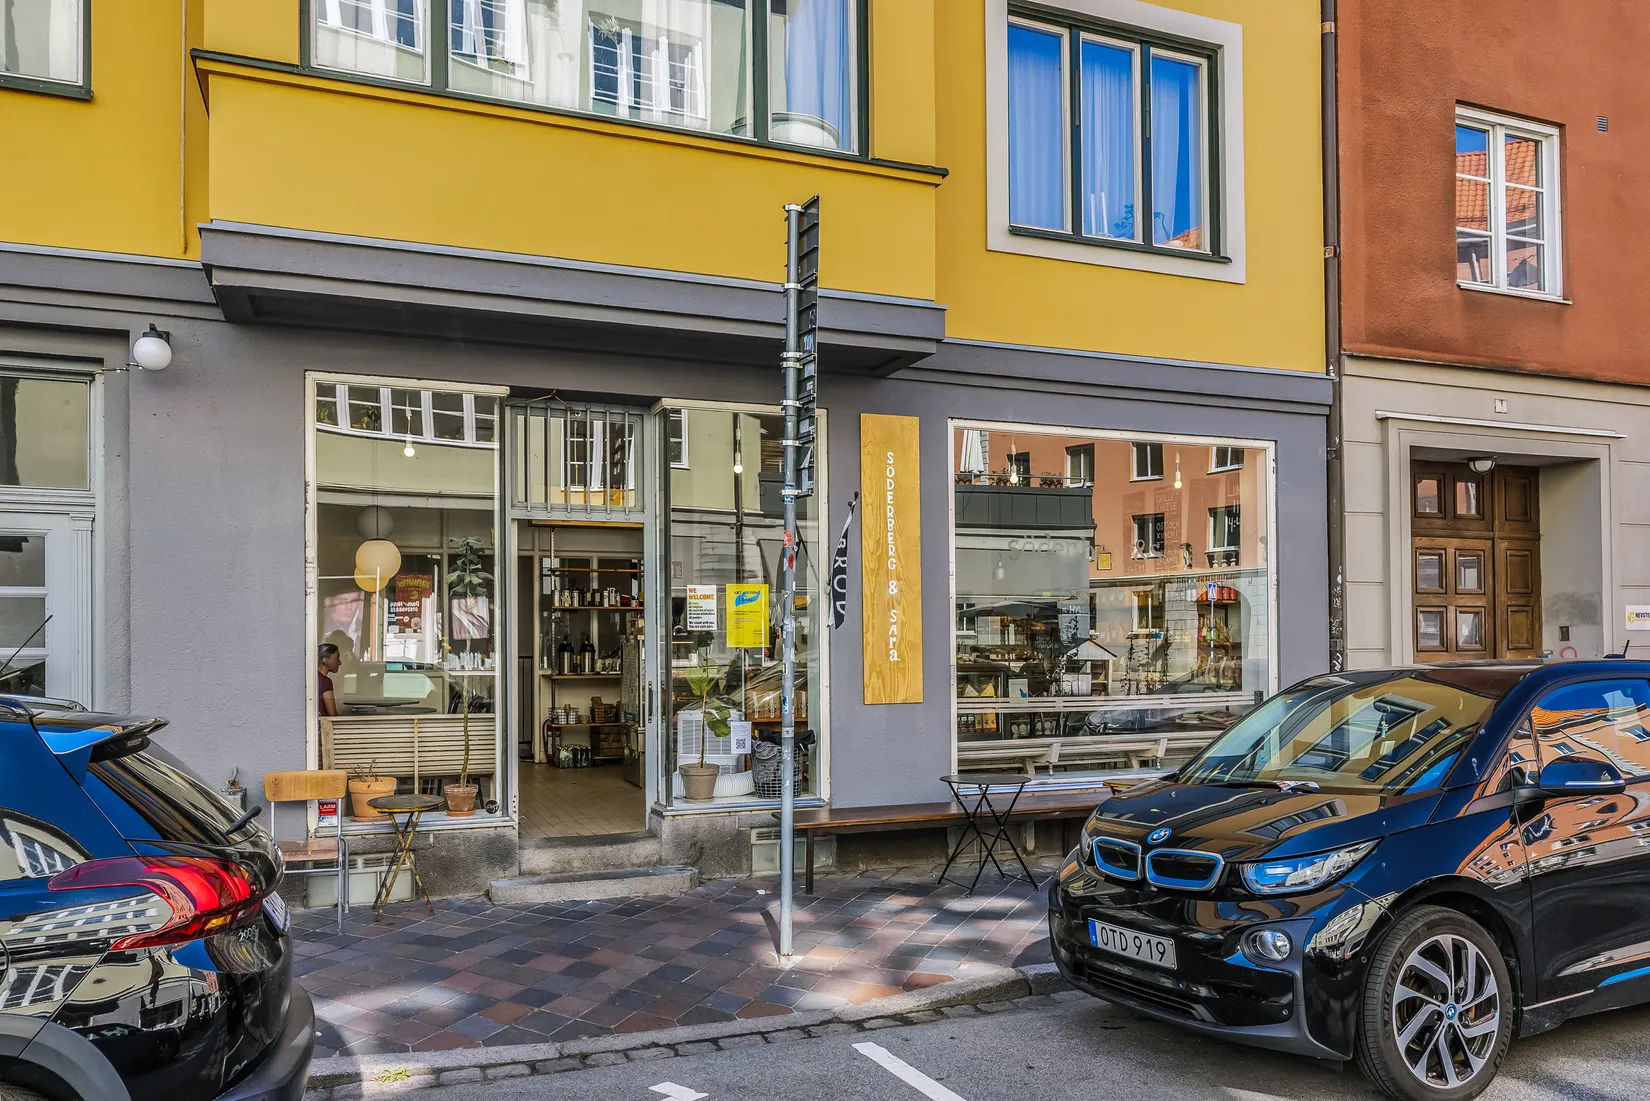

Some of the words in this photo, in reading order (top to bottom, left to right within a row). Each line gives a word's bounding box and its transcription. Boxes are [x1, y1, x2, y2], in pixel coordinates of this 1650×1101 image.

[886, 451, 896, 570] SÖDERBERG
[1156, 502, 1178, 513] CHEESE
[888, 580, 898, 594] &
[1101, 926, 1128, 952] OTD
[1133, 935, 1166, 962] 919
